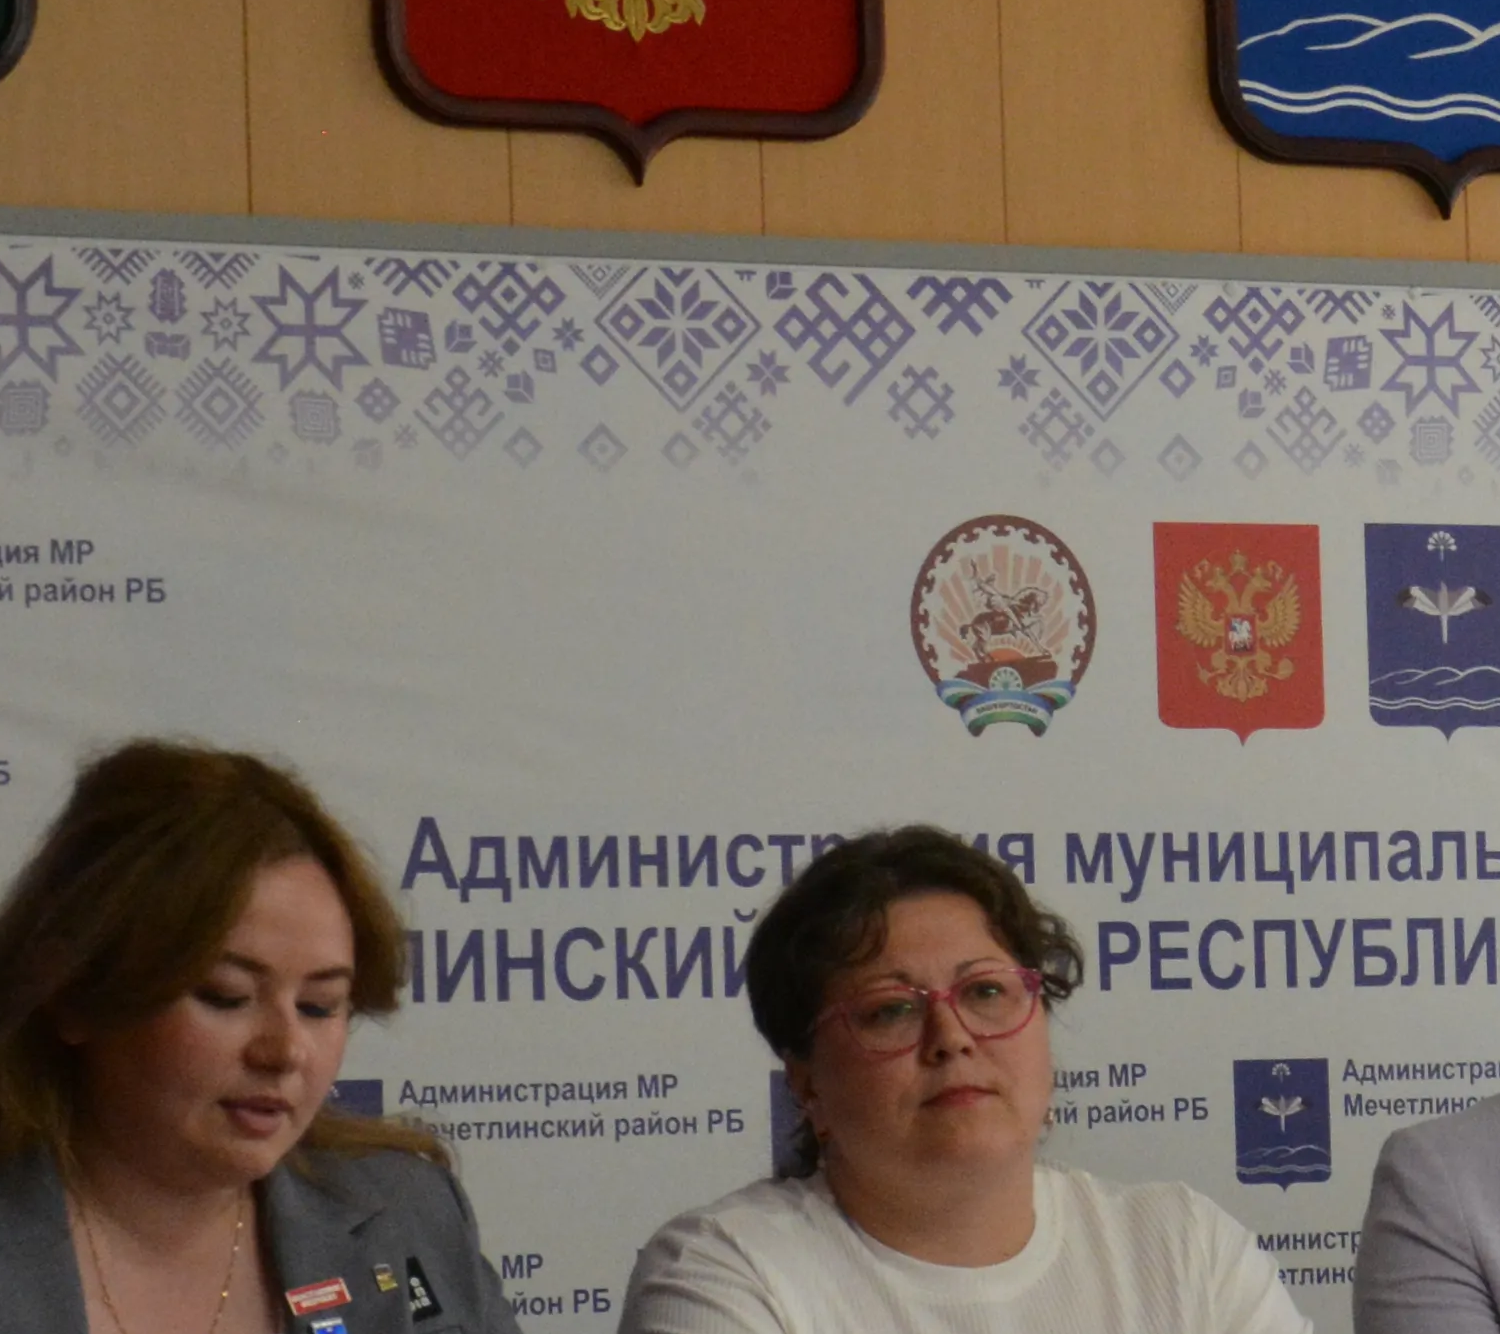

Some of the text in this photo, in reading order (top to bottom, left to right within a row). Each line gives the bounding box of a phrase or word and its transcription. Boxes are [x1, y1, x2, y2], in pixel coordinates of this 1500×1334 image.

[50, 539, 94, 564] МР
[25, 576, 115, 608] район
[125, 578, 166, 604] РБ
[400, 1074, 678, 1106] Администрация МР
[1109, 1064, 1146, 1088] МР
[615, 1112, 696, 1142] район
[708, 1109, 743, 1133] РБ
[1088, 1102, 1166, 1128] район
[1174, 1098, 1208, 1121] РБ
[502, 1254, 543, 1279] МР
[511, 1287, 611, 1316] йон РБ
